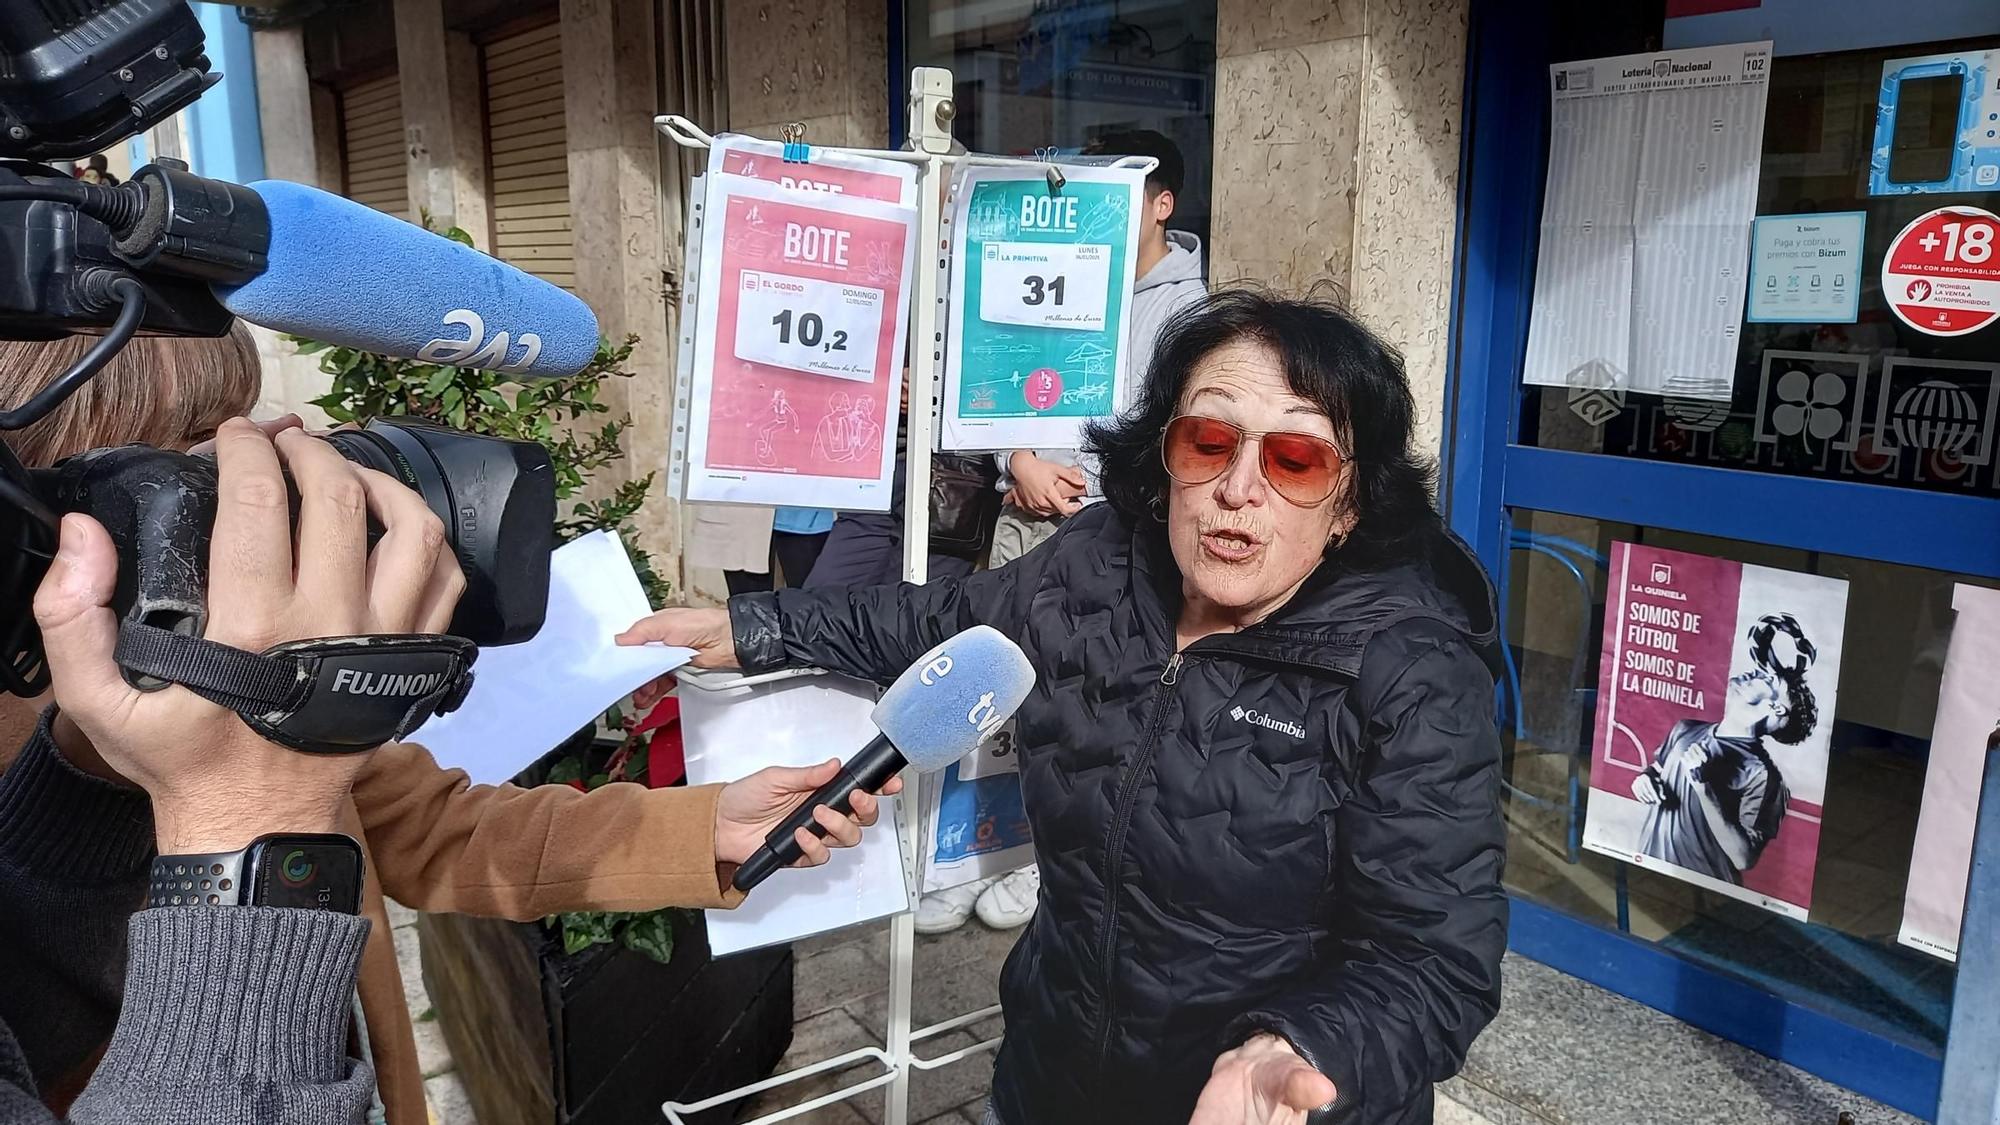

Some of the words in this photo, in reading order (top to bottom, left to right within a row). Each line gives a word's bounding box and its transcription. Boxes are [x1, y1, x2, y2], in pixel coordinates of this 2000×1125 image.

[1622, 67, 1652, 78] Lotería
[1671, 61, 1712, 74] Nacional
[1701, 74, 1732, 83] NAVIDAD
[1746, 59, 1764, 72] 102
[1020, 195, 1078, 229] BOTE
[784, 222, 850, 266] BOTE
[1768, 251, 1798, 259] premios
[1818, 249, 1846, 257] Bizum
[1774, 238, 1794, 248] Paga
[1803, 238, 1826, 246] cobra
[1920, 222, 1994, 264] +18
[762, 280, 772, 288] EL
[774, 282, 804, 292] GORDO
[842, 288, 878, 300] DOMINGO
[1022, 275, 1066, 306] 31
[1934, 297, 1990, 306] AUTOPROHIBIDOS
[772, 309, 848, 353] 10,2
[396, 452, 416, 483] FUJINON
[1631, 584, 1643, 593] LA
[1644, 586, 1688, 600] QUINIELA
[1629, 602, 1680, 628] SOMOS
[1682, 613, 1702, 634] DE
[1627, 622, 1680, 654] FÚTBOL
[331, 668, 441, 696] FUJINON
[1625, 650, 1674, 678] SOMOS
[1676, 662, 1696, 684] DE
[1622, 672, 1640, 694] LA
[1642, 677, 1704, 710] QUINIELA
[1244, 709, 1306, 739] Columbia
